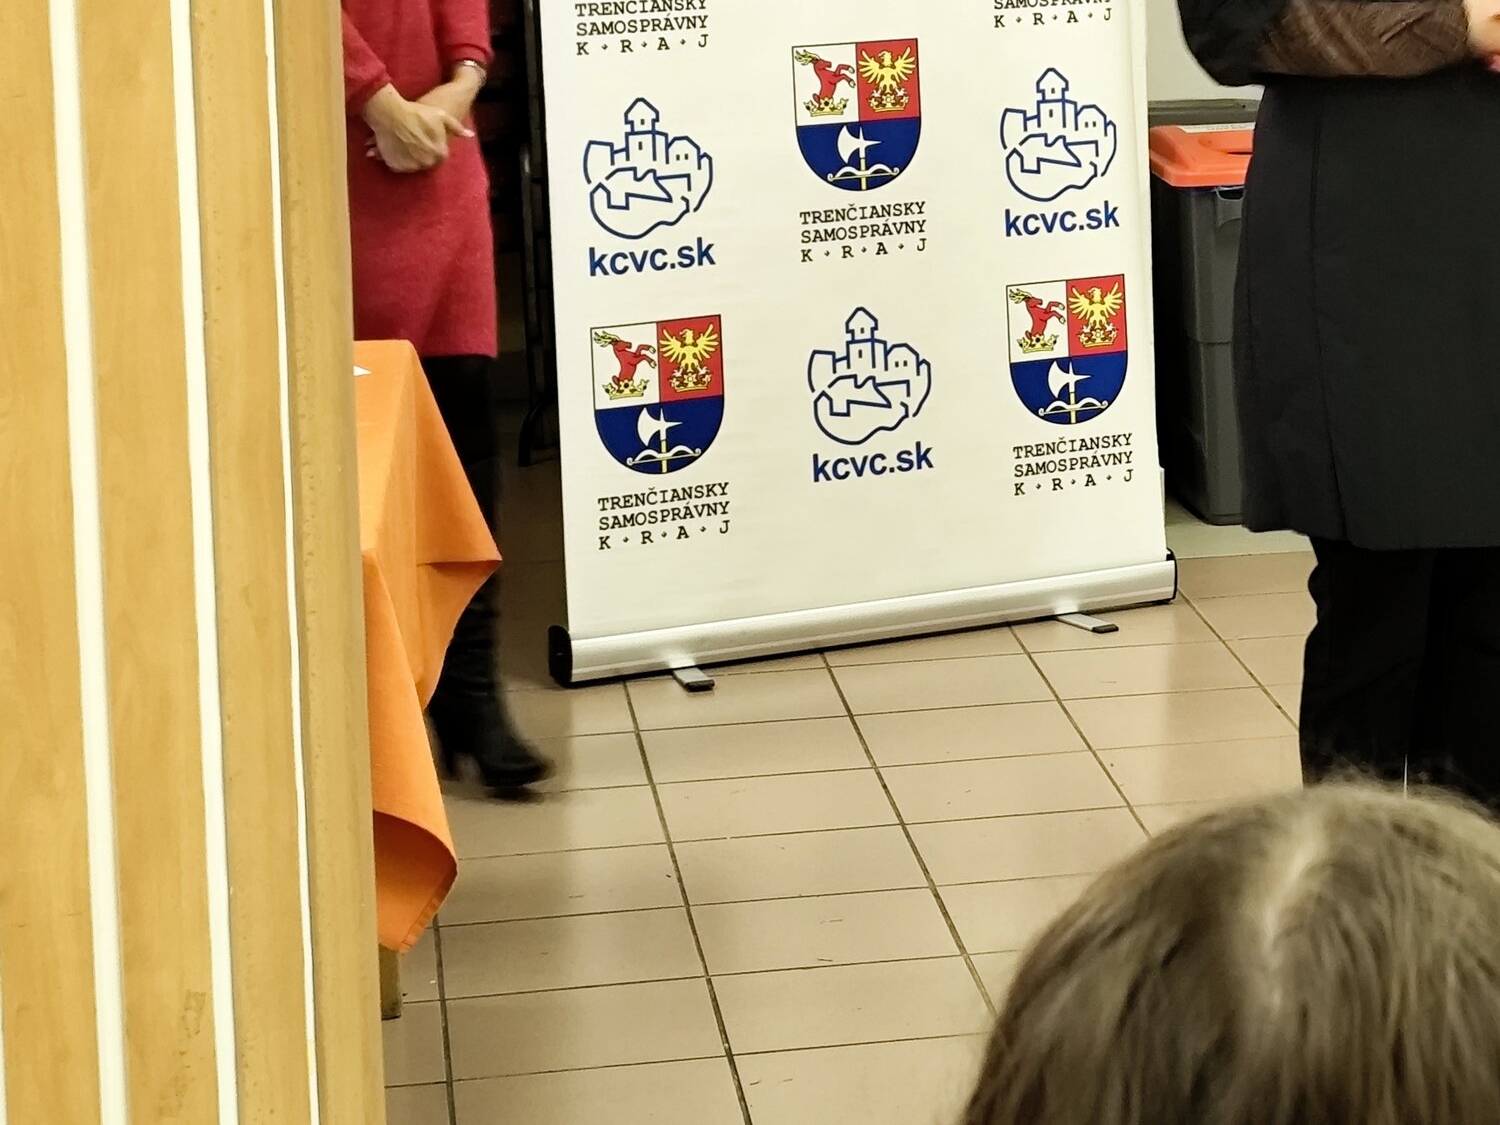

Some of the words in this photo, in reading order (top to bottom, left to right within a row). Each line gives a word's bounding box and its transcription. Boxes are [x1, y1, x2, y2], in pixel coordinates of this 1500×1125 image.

[577, 14, 708, 36] SAMOSPRÁVNY
[800, 201, 925, 224] TRENČIANSKY
[1004, 201, 1119, 237] kcvc.sk
[802, 220, 926, 243] SAMOSPRÁVNY
[588, 237, 715, 276] kcvc.sk
[1013, 433, 1132, 459] TRENČIANSKY
[812, 441, 933, 482] kcvc.sk
[1015, 451, 1132, 477] SAMOSPRÁVNY
[598, 482, 729, 511] TRENČIANSKY
[599, 501, 729, 530] SAMOSPRÁVNY
